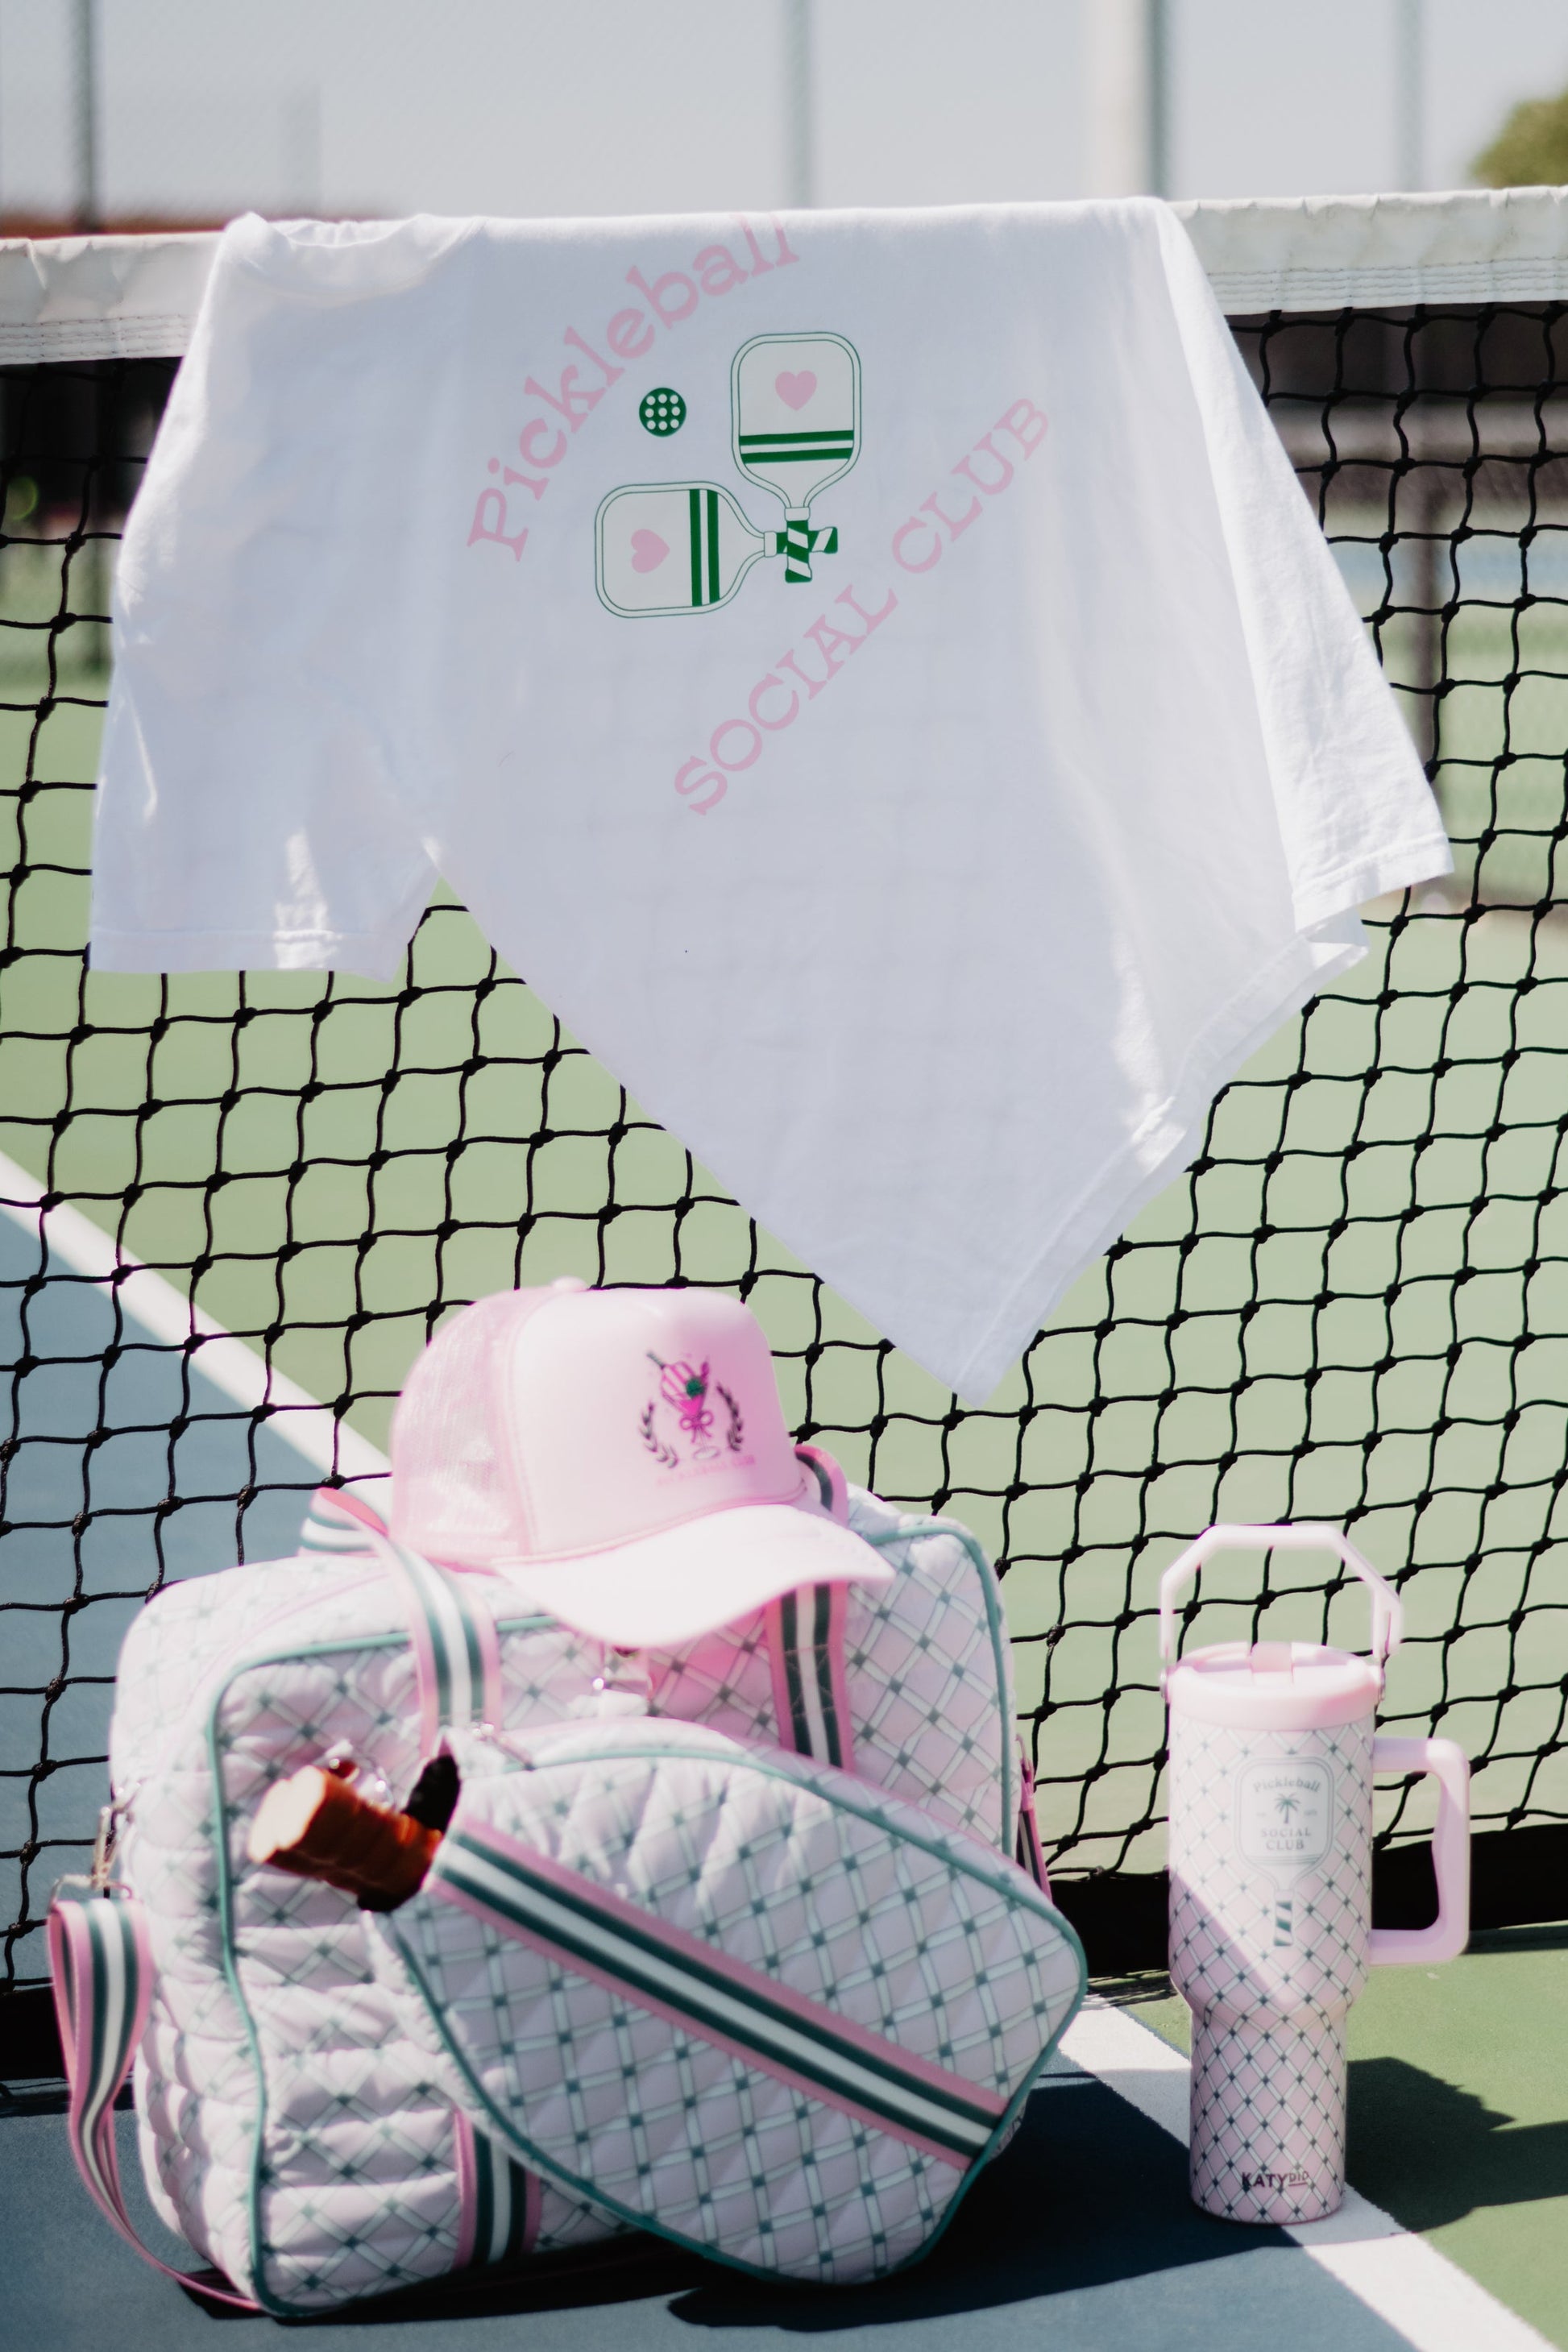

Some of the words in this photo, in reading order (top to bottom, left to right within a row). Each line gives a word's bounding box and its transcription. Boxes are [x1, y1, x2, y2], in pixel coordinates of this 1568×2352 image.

[467, 213, 799, 562] Pickleball
[674, 584, 898, 815] SOCIAL
[890, 397, 1049, 574] CLUB
[1252, 1776, 1321, 1793] Pickleball
[1260, 1827, 1312, 1838] SOCIAL
[1266, 1839, 1305, 1851] CLUB
